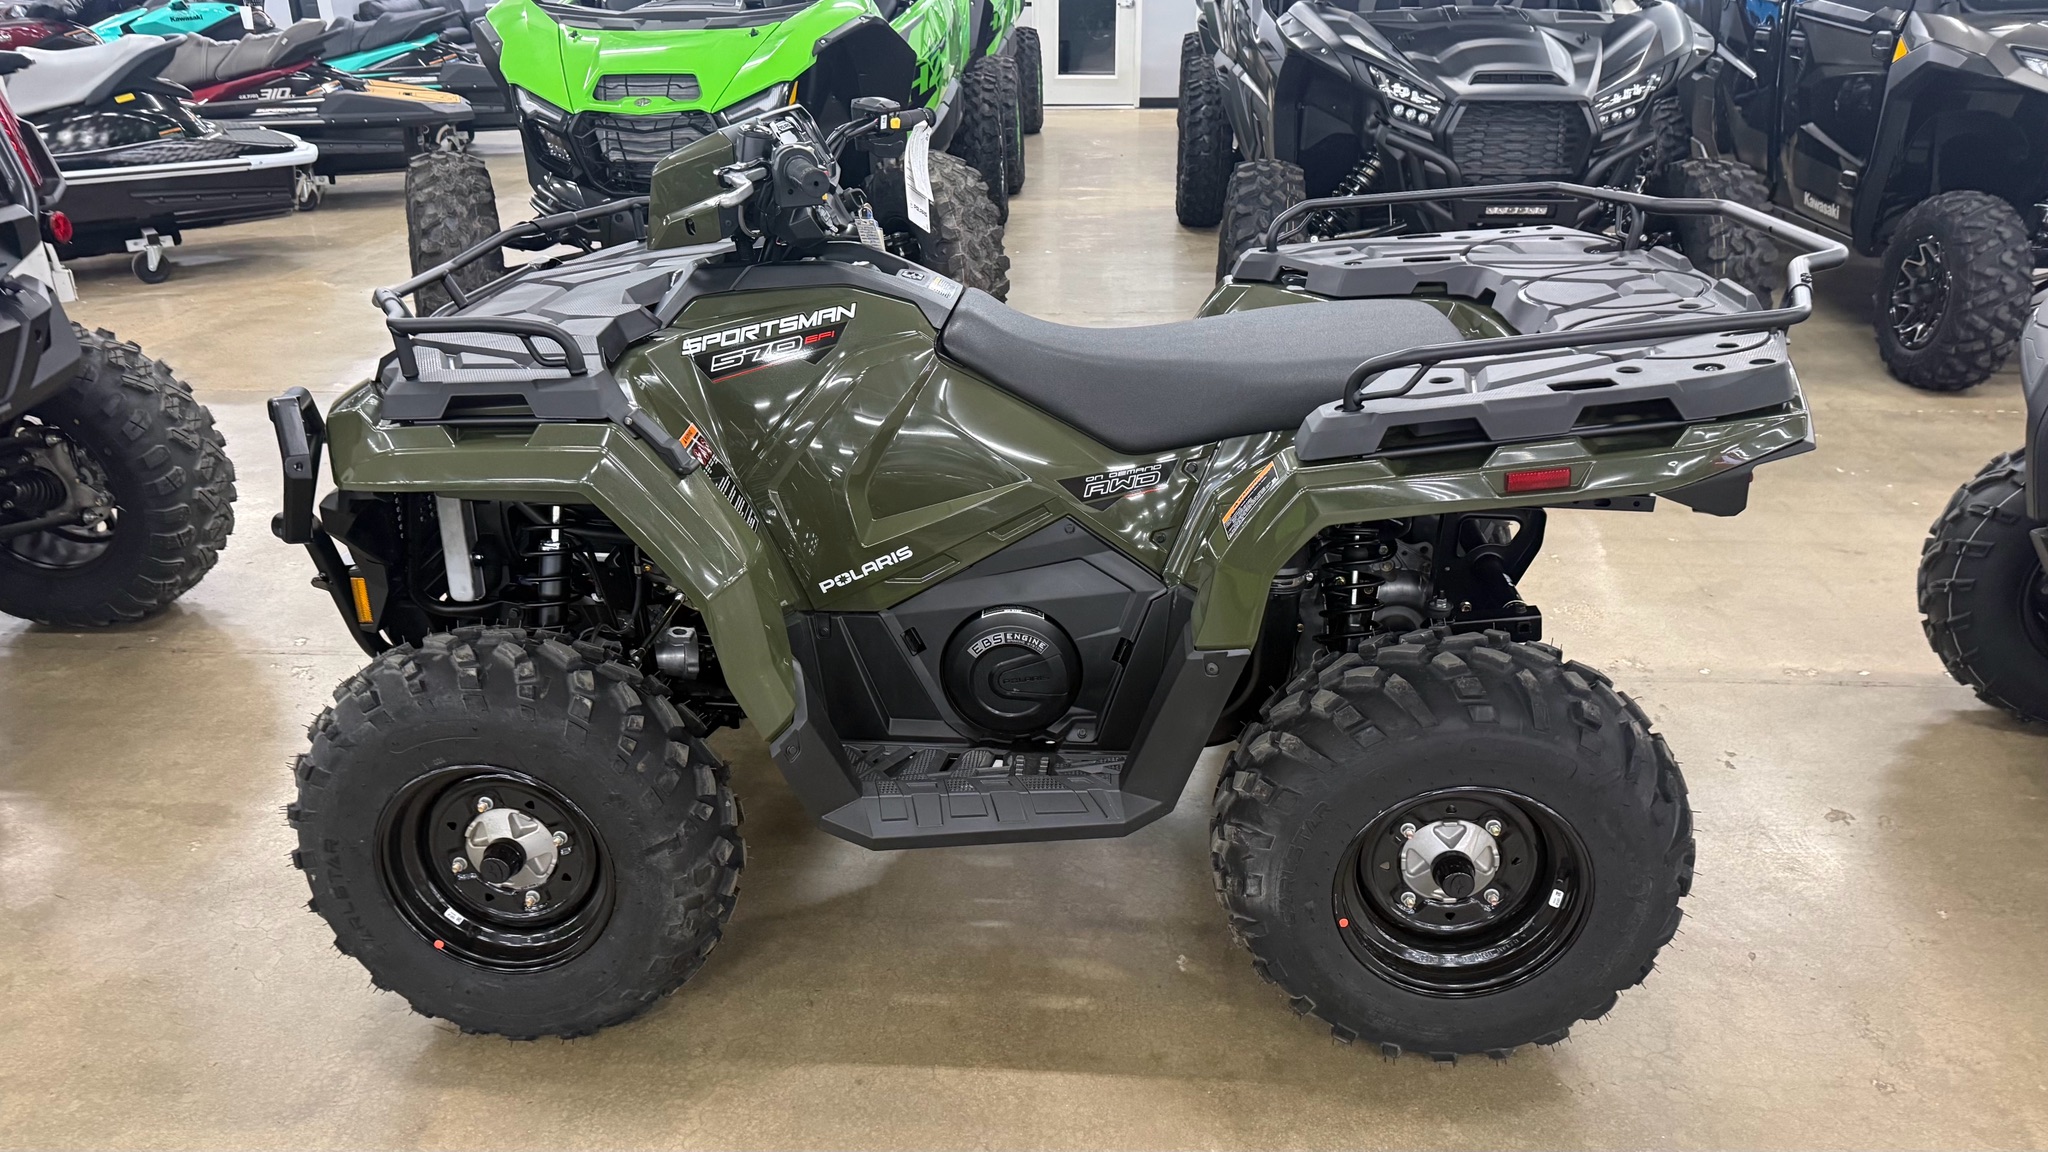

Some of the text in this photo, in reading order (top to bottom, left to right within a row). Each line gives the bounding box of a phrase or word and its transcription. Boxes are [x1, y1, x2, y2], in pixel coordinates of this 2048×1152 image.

[169, 14, 204, 23] Kawasaki
[258, 87, 292, 101] 310
[1803, 191, 1840, 220] Kawasaki
[681, 302, 858, 357] SPORTSMAN
[710, 330, 836, 373] 570 EFI
[1083, 470, 1161, 498] AWD
[1085, 463, 1162, 483] ON DEMAND
[818, 545, 914, 594] POLARIS
[971, 632, 1047, 655] EBS ENGINE
